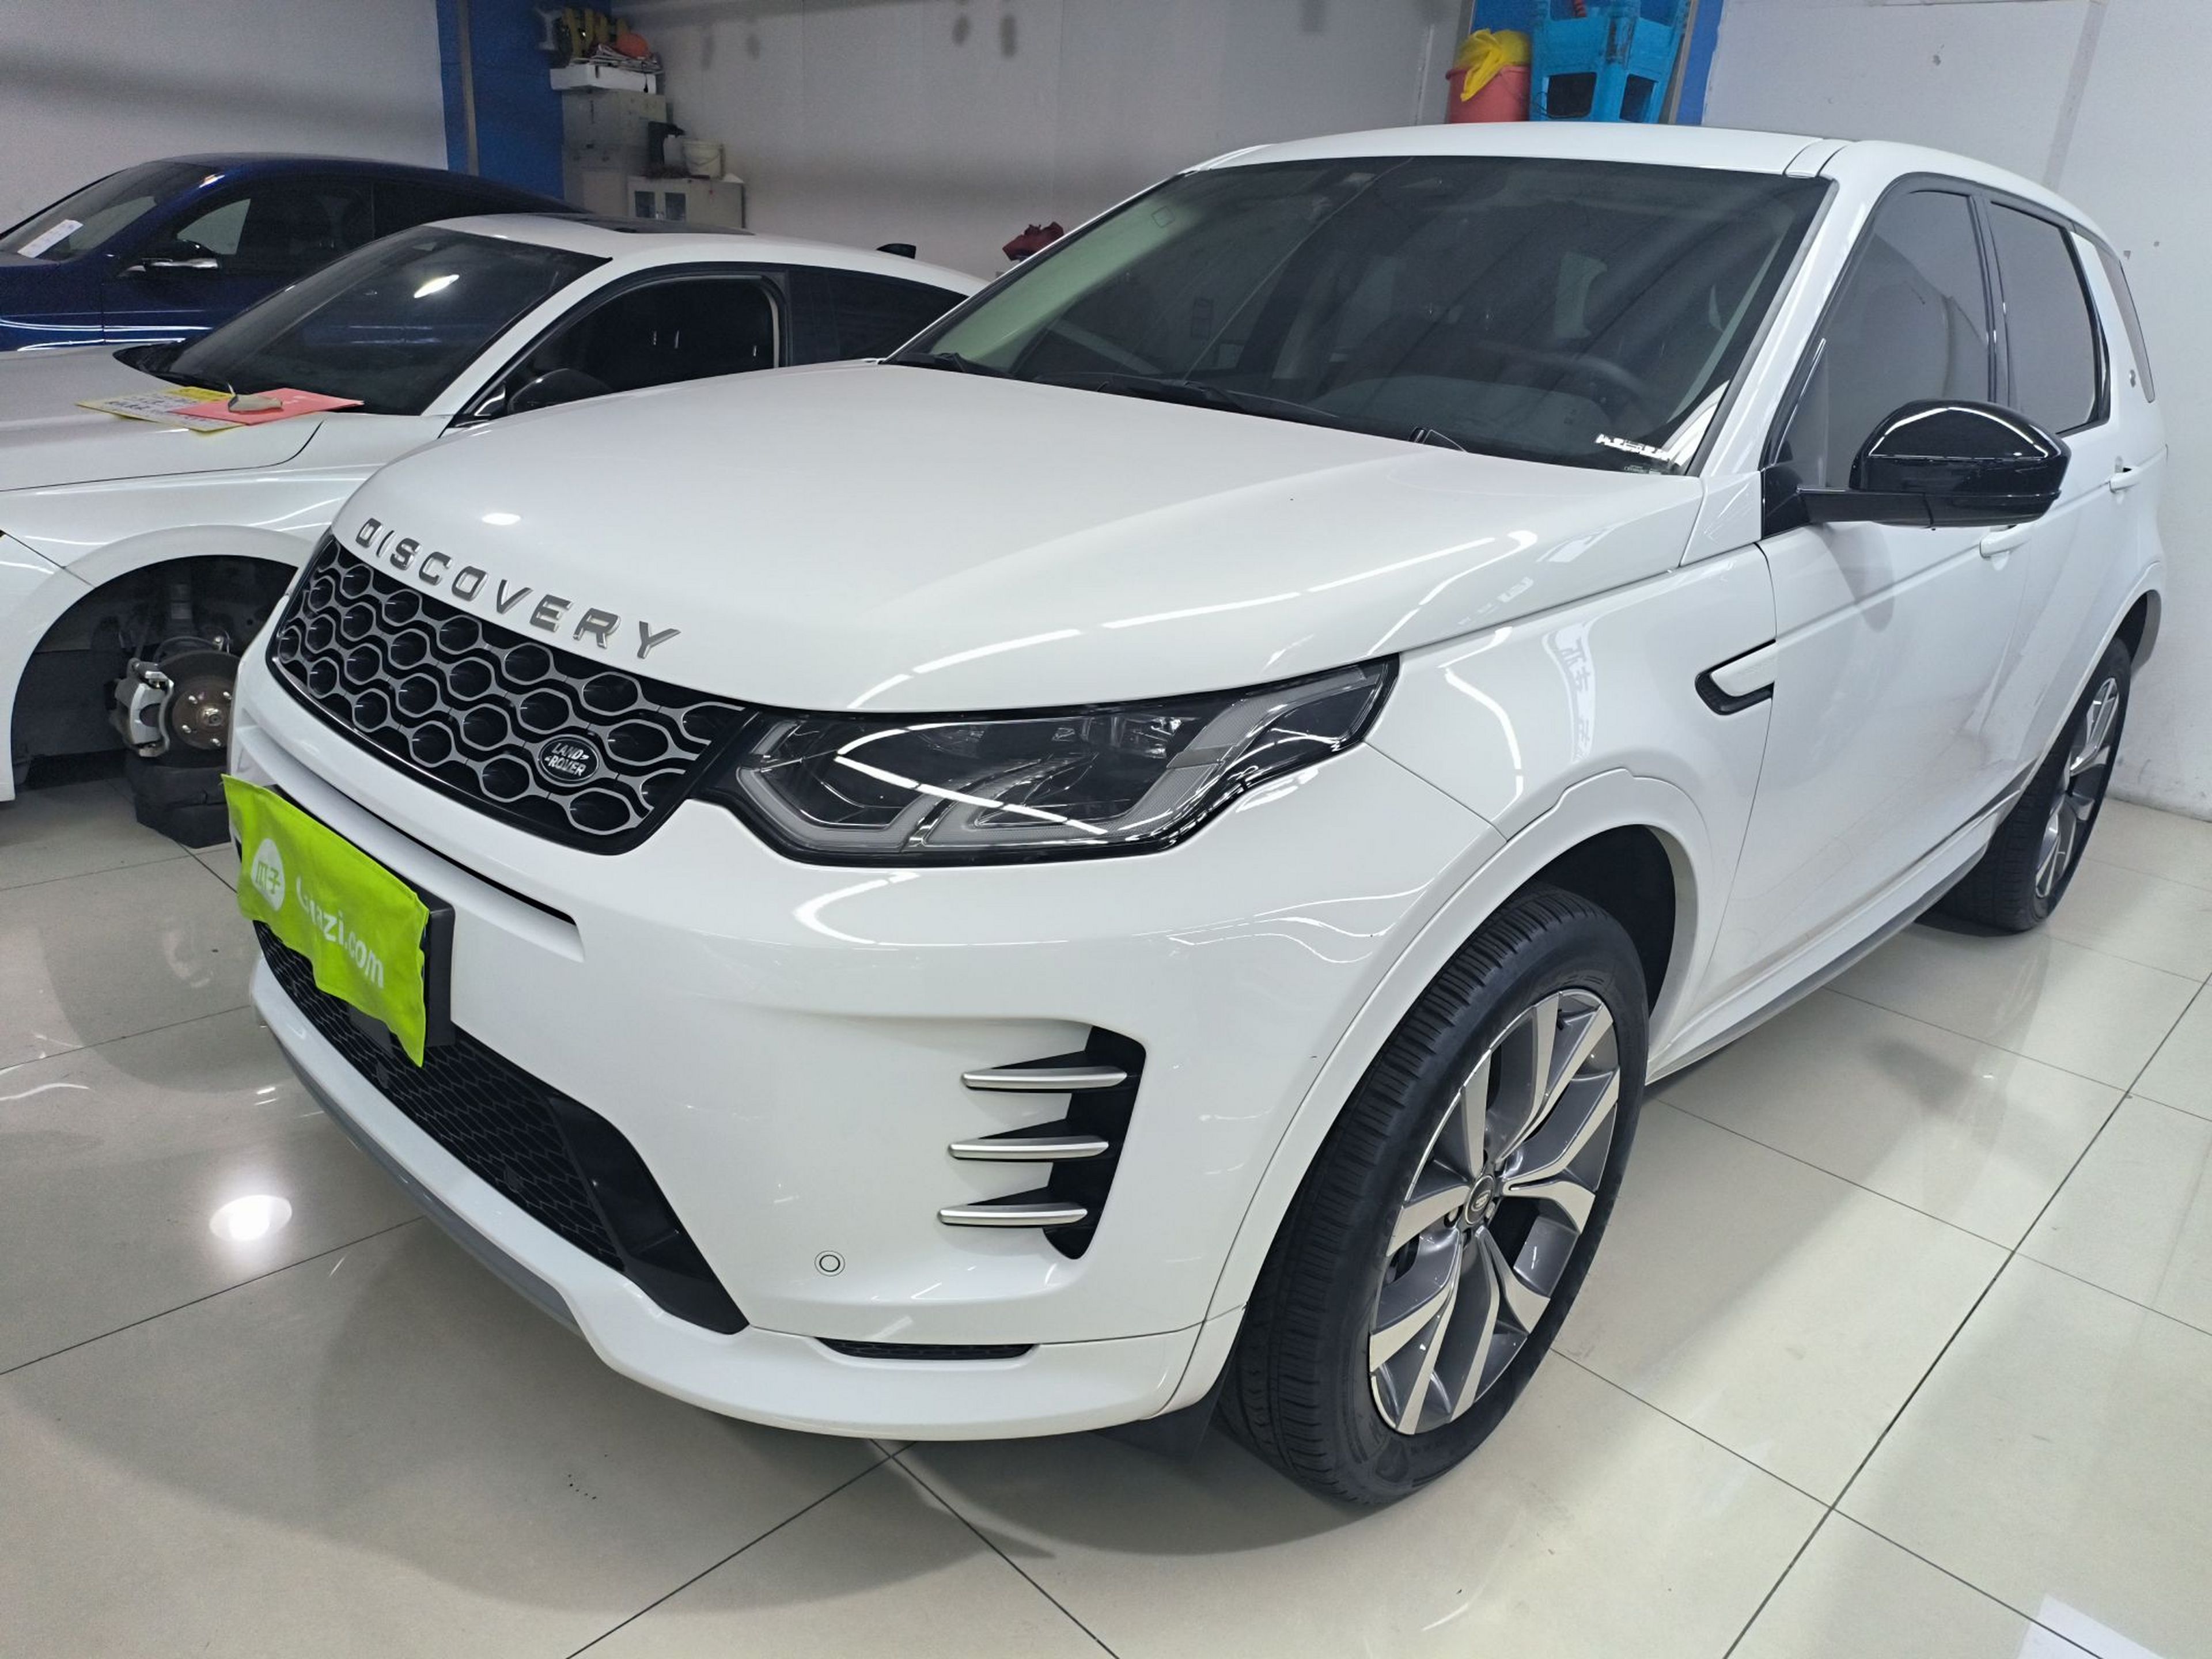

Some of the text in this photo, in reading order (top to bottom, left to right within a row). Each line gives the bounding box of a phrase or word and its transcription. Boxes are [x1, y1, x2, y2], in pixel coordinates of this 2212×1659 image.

[355, 518, 681, 660] DISCOVERY
[551, 743, 584, 760] LAND
[548, 755, 586, 777] ROVER
